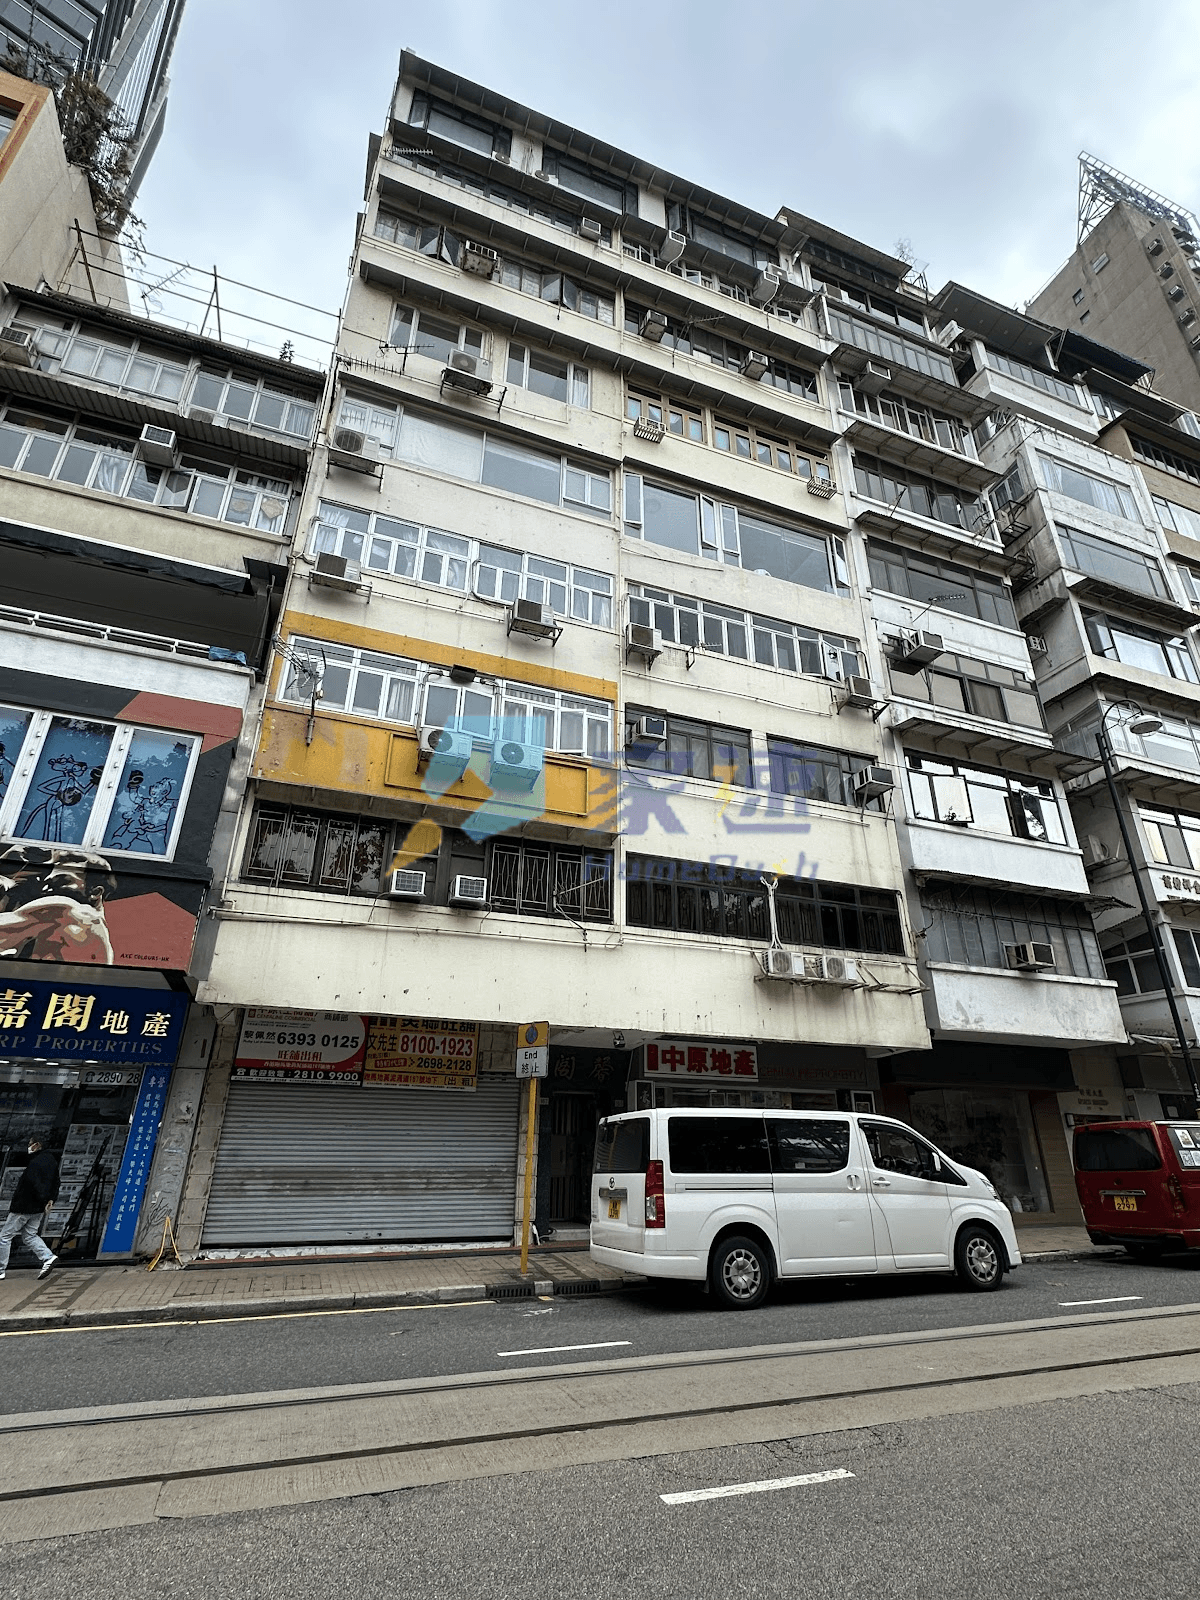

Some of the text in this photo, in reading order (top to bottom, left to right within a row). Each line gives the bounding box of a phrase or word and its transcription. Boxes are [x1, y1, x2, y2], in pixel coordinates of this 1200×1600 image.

[0, 988, 171, 1037] 嘉閣地產
[34, 1035, 163, 1055] PROPERTIES
[277, 1032, 316, 1046] 6393
[321, 1034, 360, 1049] 0125
[367, 1033, 473, 1056] 文先生 8100-1923
[524, 1050, 538, 1059] End
[661, 1045, 756, 1075] 中原地產
[417, 1057, 471, 1071] 2698-2128
[521, 1062, 539, 1074] 終止
[97, 1071, 122, 1084] 2890
[294, 1070, 324, 1079] 2810
[328, 1072, 359, 1081] 9900
